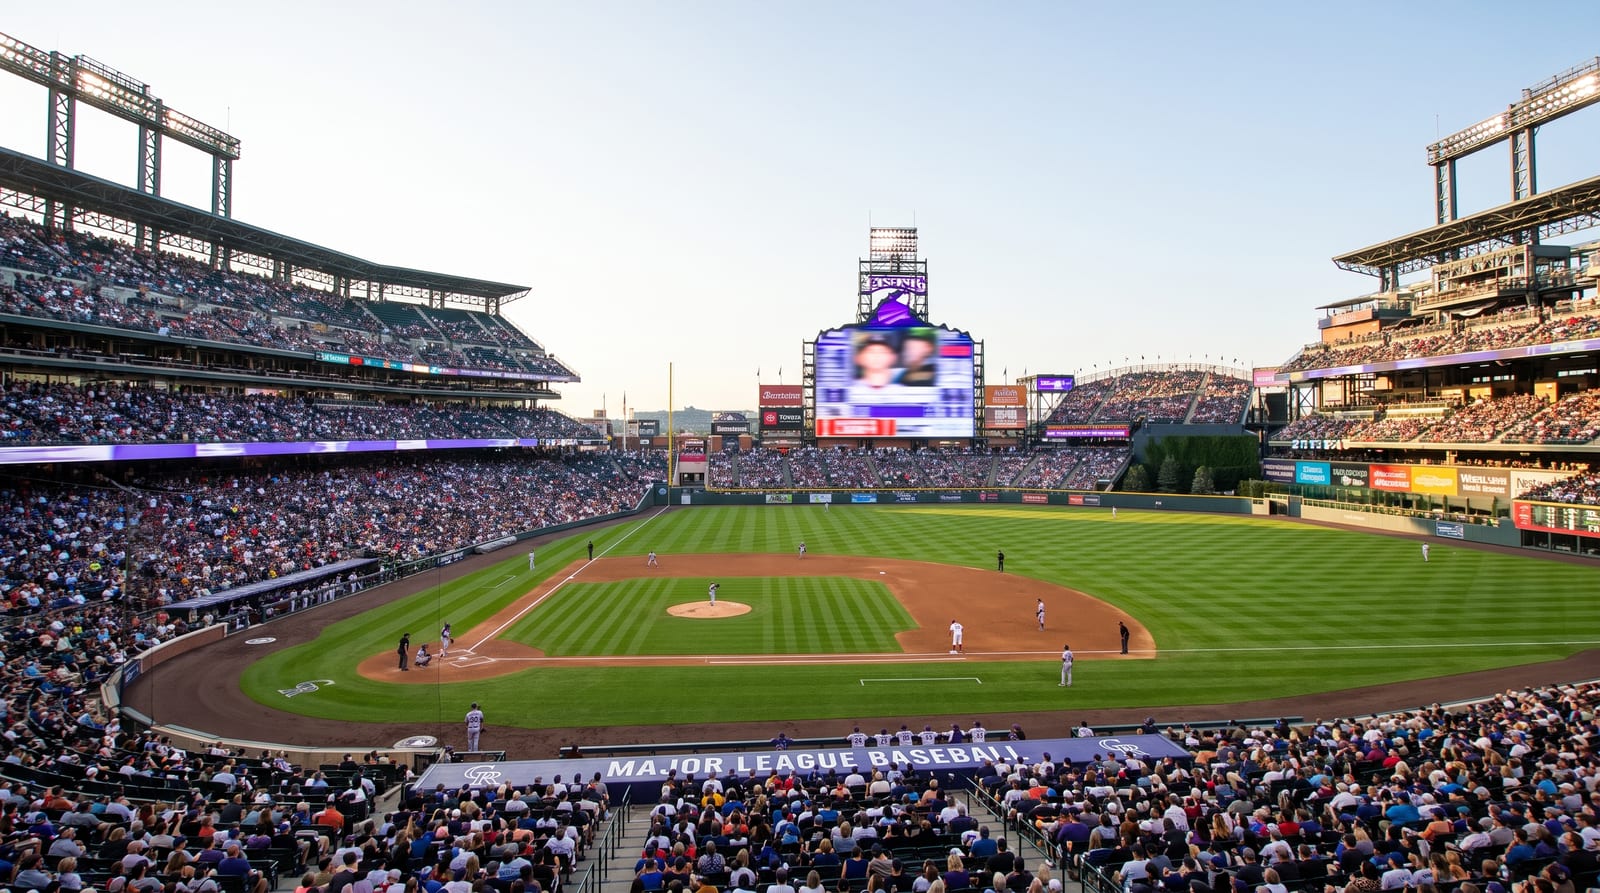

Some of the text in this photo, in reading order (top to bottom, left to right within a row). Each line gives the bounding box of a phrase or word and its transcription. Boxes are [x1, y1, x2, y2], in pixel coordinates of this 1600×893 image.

[607, 745, 1029, 777] MAJOR LEAGUE BASEBALL
